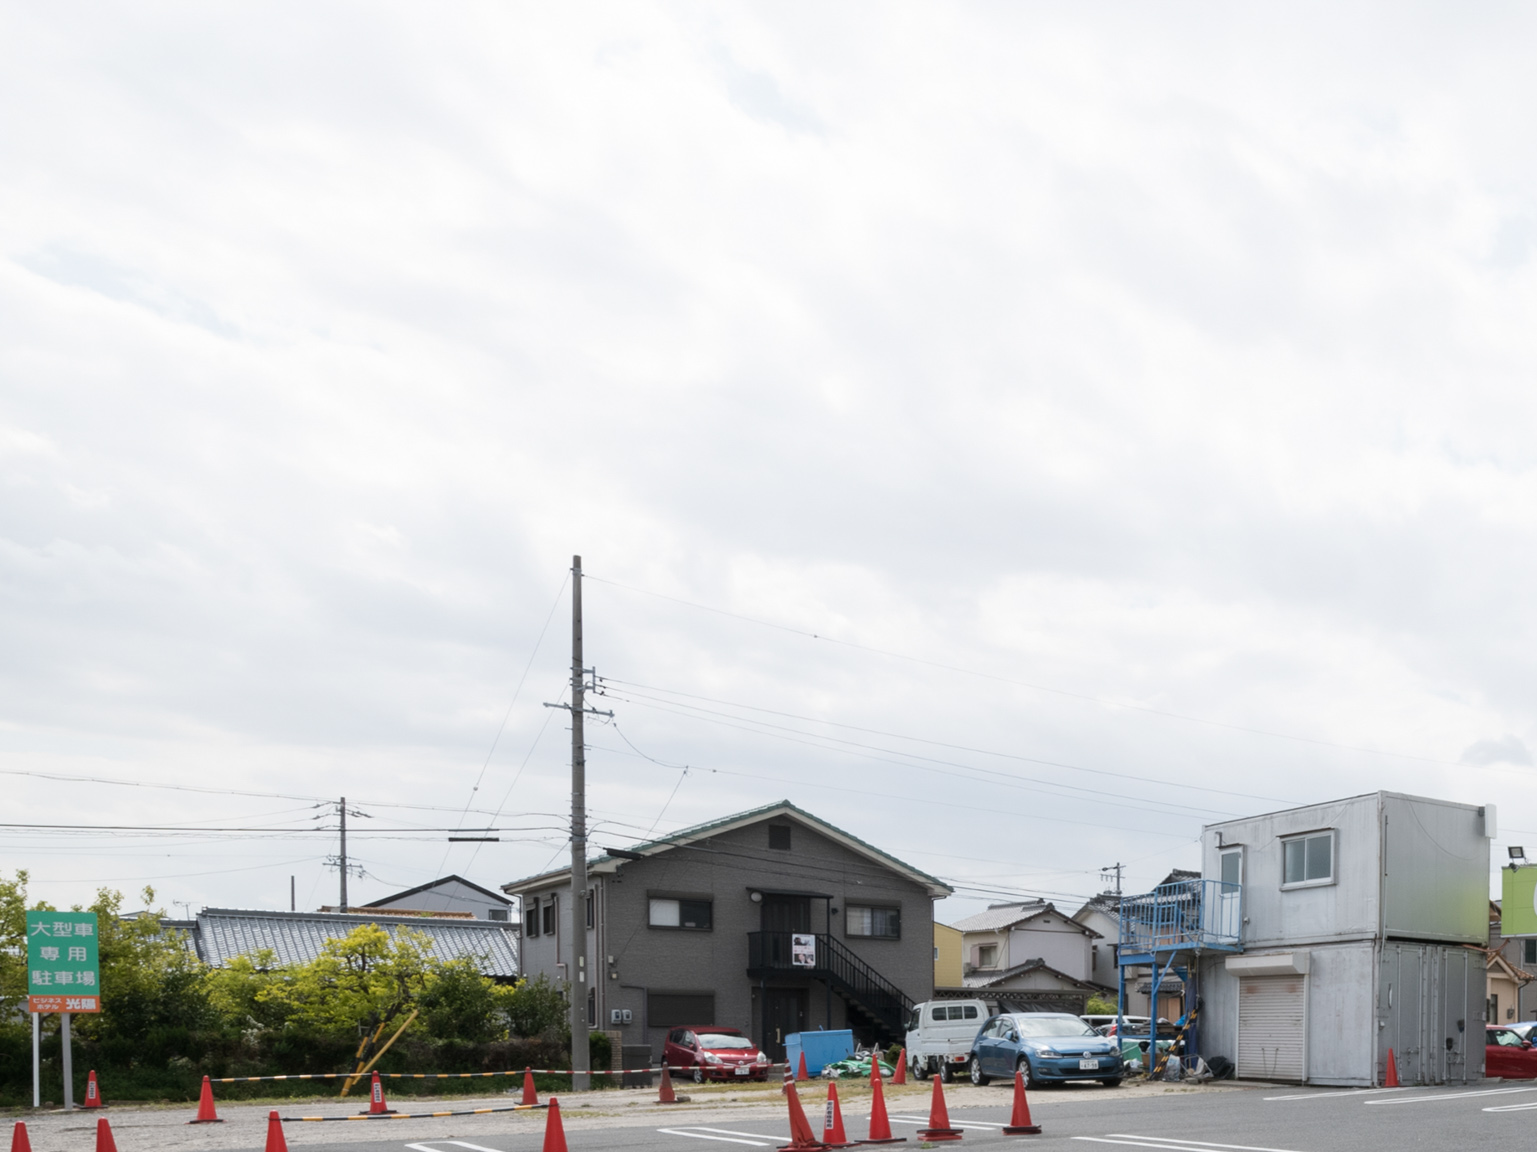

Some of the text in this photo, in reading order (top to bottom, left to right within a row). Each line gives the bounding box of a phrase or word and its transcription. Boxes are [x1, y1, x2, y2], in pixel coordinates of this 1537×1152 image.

[30, 921, 94, 937] 大型車
[40, 946, 87, 961] 専用
[32, 970, 96, 986] 駐車場
[65, 998, 96, 1010] 光陽
